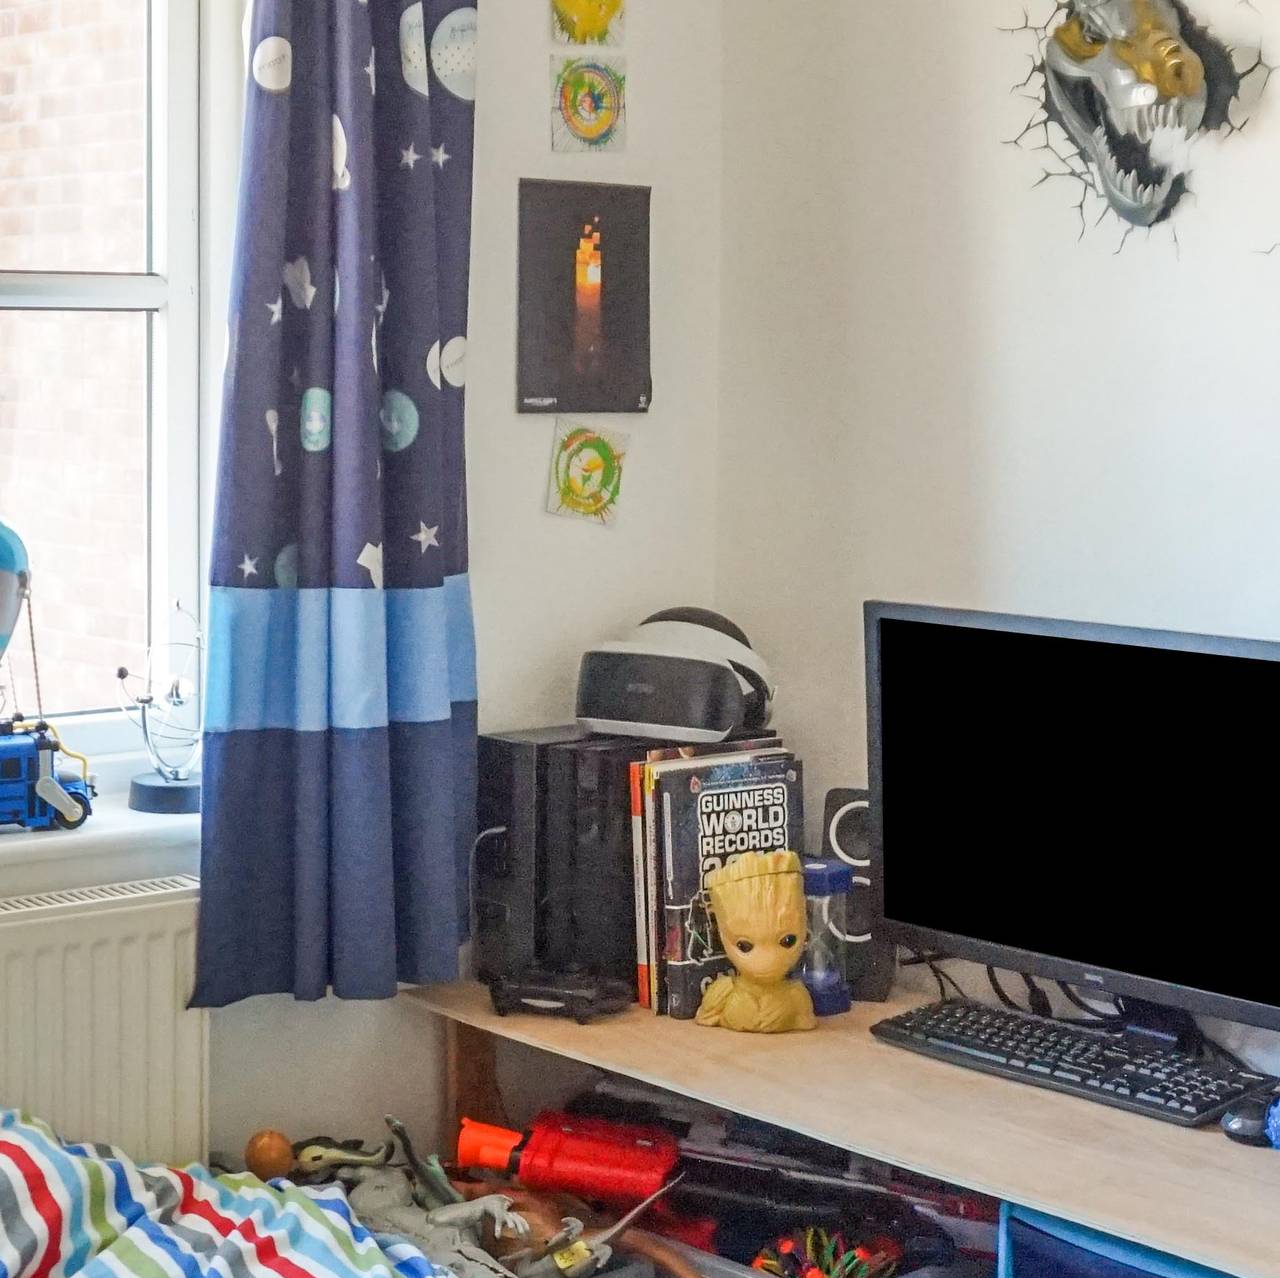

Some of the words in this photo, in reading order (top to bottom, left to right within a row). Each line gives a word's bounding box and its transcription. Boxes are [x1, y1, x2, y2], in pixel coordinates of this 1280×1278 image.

[701, 787, 784, 813] GUINNESS
[701, 805, 785, 836] WORLD
[702, 827, 785, 856] RECORDS
